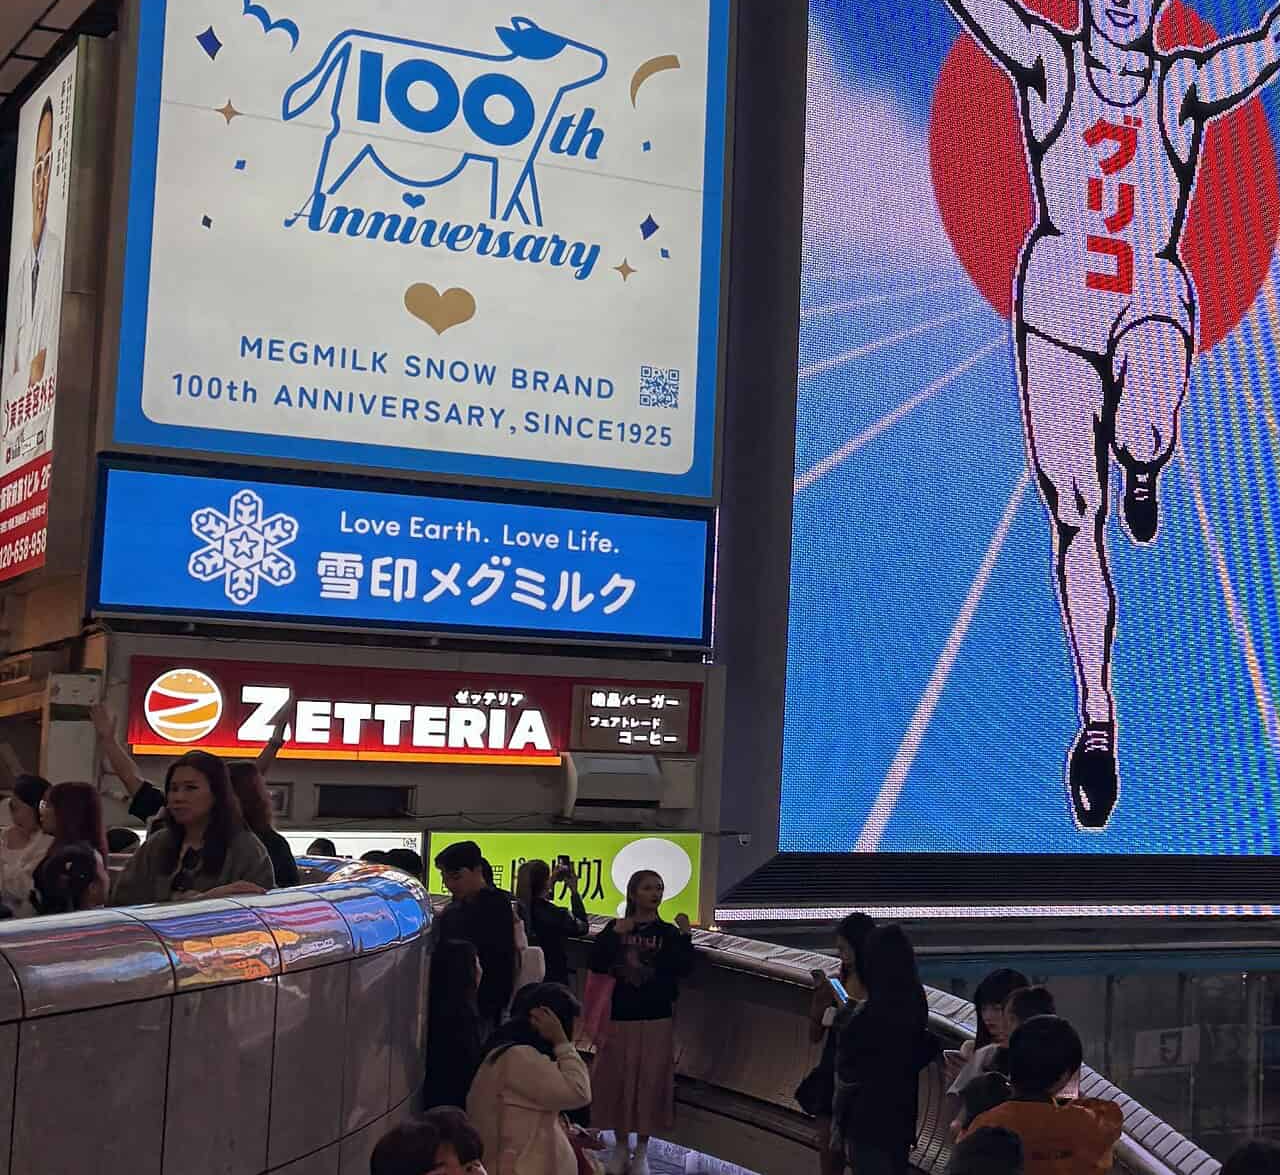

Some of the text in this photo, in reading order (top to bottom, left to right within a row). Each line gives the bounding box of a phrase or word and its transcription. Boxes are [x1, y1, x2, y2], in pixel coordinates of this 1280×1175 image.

[1082, 114, 1143, 296] グリコ
[284, 190, 601, 281] Anniversary
[172, 372, 258, 405] 100th
[240, 335, 616, 400] MEGMILK SNOW BRAND
[340, 511, 620, 554] Love Earth. Love Life.
[317, 551, 637, 615] 雪印メグミルク
[236, 685, 553, 751] ZETTERIA
[455, 690, 525, 707] ゼッテリア
[589, 716, 661, 730] フェアトレード
[618, 731, 679, 746] コーヒー
